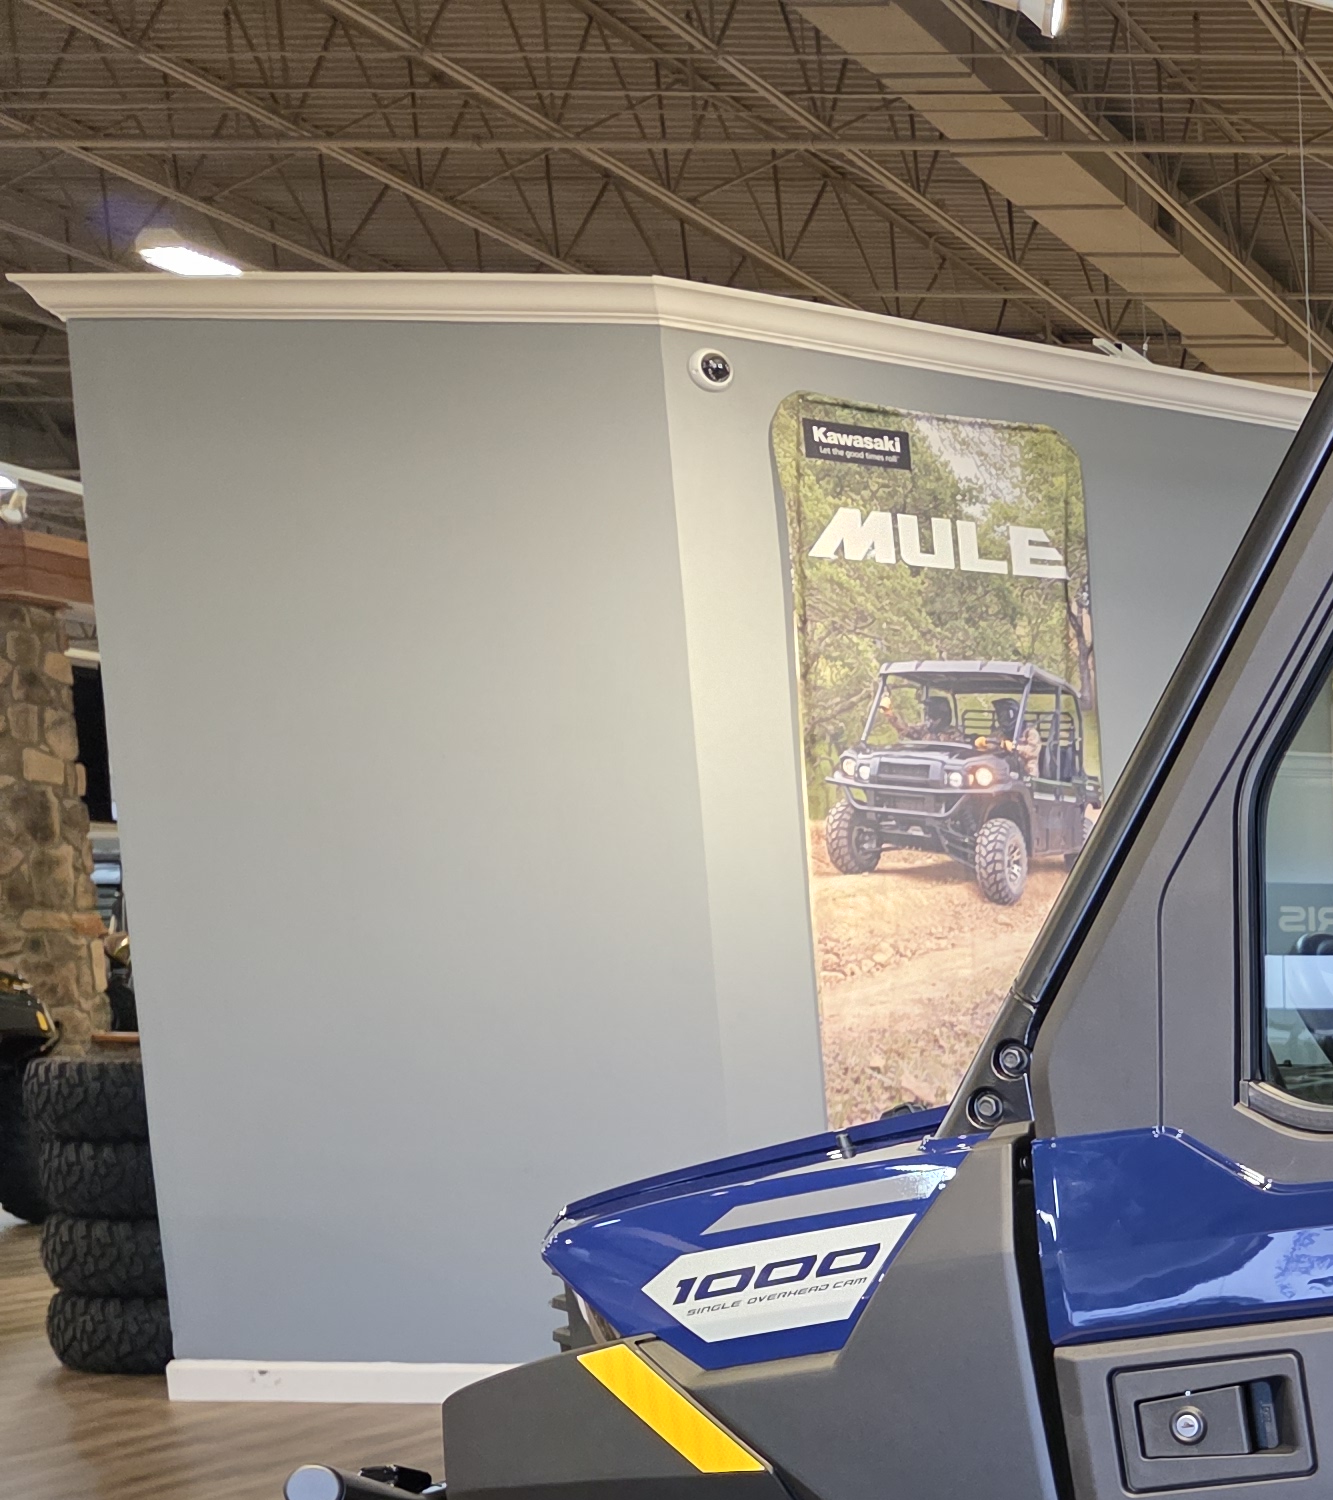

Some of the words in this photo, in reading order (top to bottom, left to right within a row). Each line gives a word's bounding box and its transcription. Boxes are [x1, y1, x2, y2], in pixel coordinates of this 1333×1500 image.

[812, 426, 901, 453] Kawasaki
[819, 446, 831, 454] Let
[832, 448, 844, 456] the
[845, 450, 864, 459] good
[865, 452, 884, 462] times
[809, 507, 1069, 580] MULE
[672, 1243, 881, 1305] 1000
[686, 1300, 740, 1316] SINGLE
[747, 1284, 829, 1305] OVERHEAD
[833, 1277, 867, 1289] CAM
